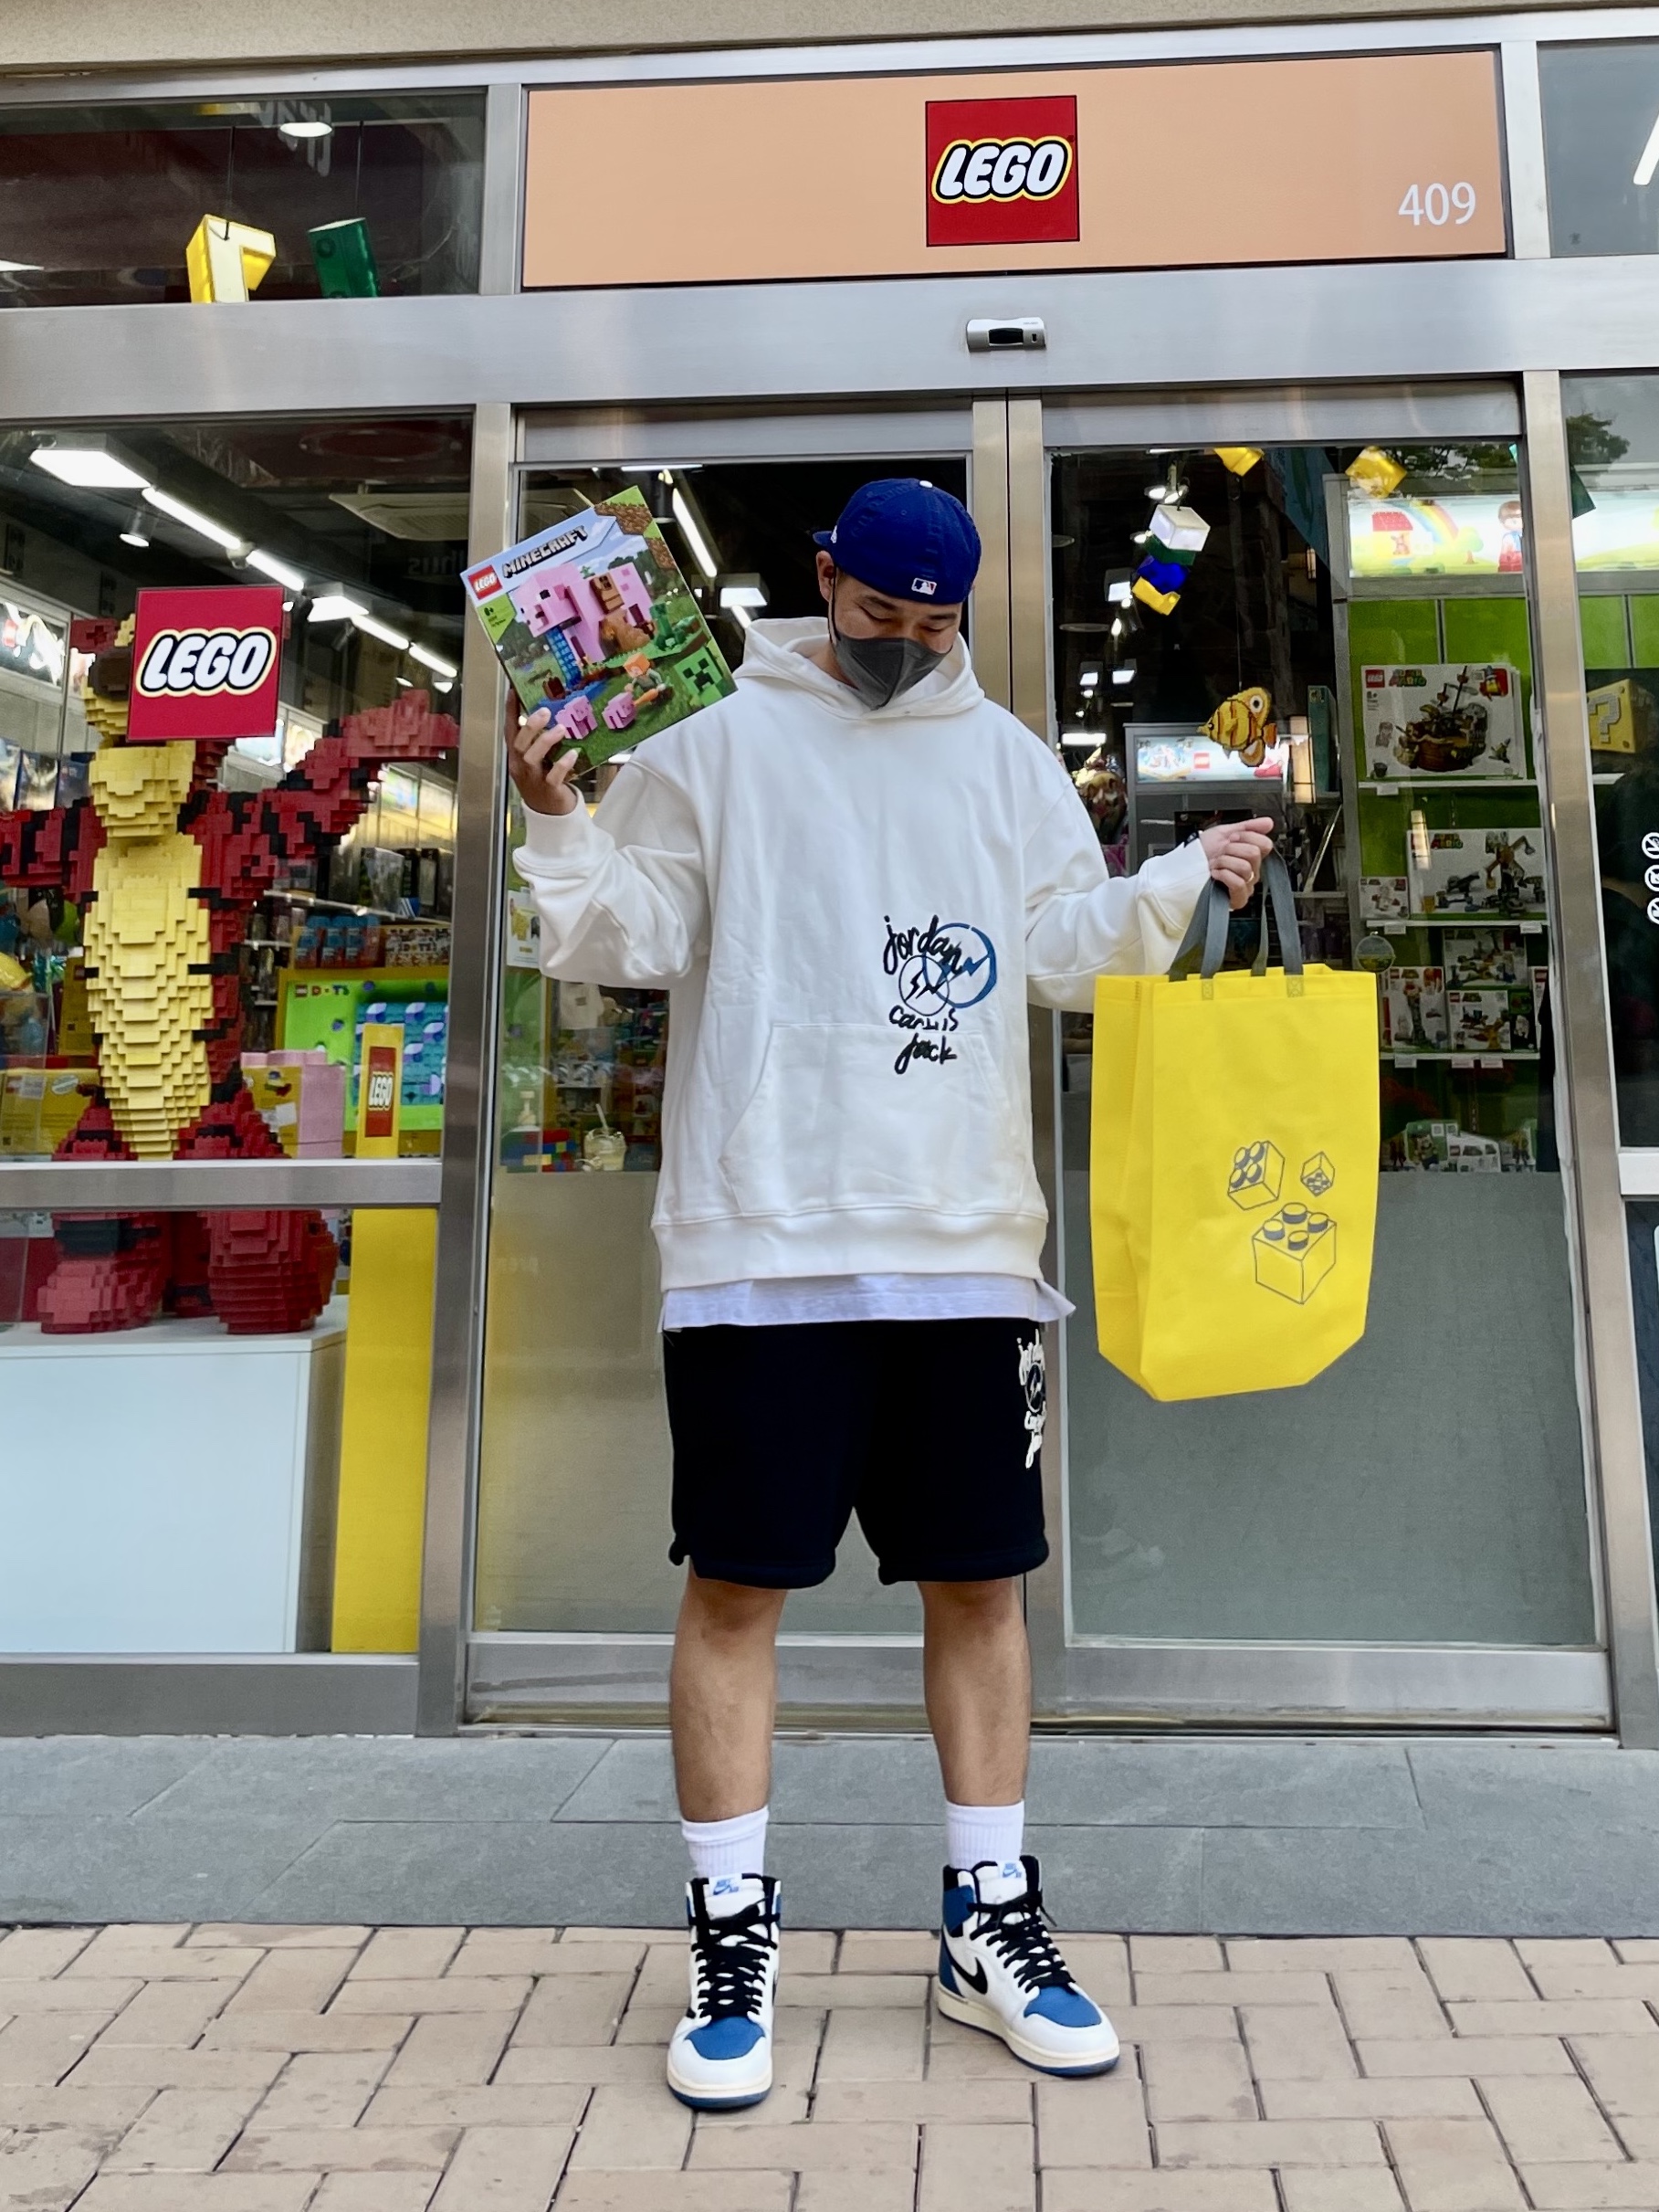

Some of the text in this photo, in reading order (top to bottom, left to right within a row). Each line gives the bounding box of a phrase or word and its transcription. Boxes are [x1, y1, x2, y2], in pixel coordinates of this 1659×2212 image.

[935, 139, 1069, 200] LEGO
[1398, 182, 1476, 226] 409
[502, 525, 588, 578] MINECRAFT
[474, 572, 498, 593] LEGO
[140, 631, 273, 693] LEGO
[894, 1032, 958, 1075] jack
[368, 1072, 394, 1110] LEGO
